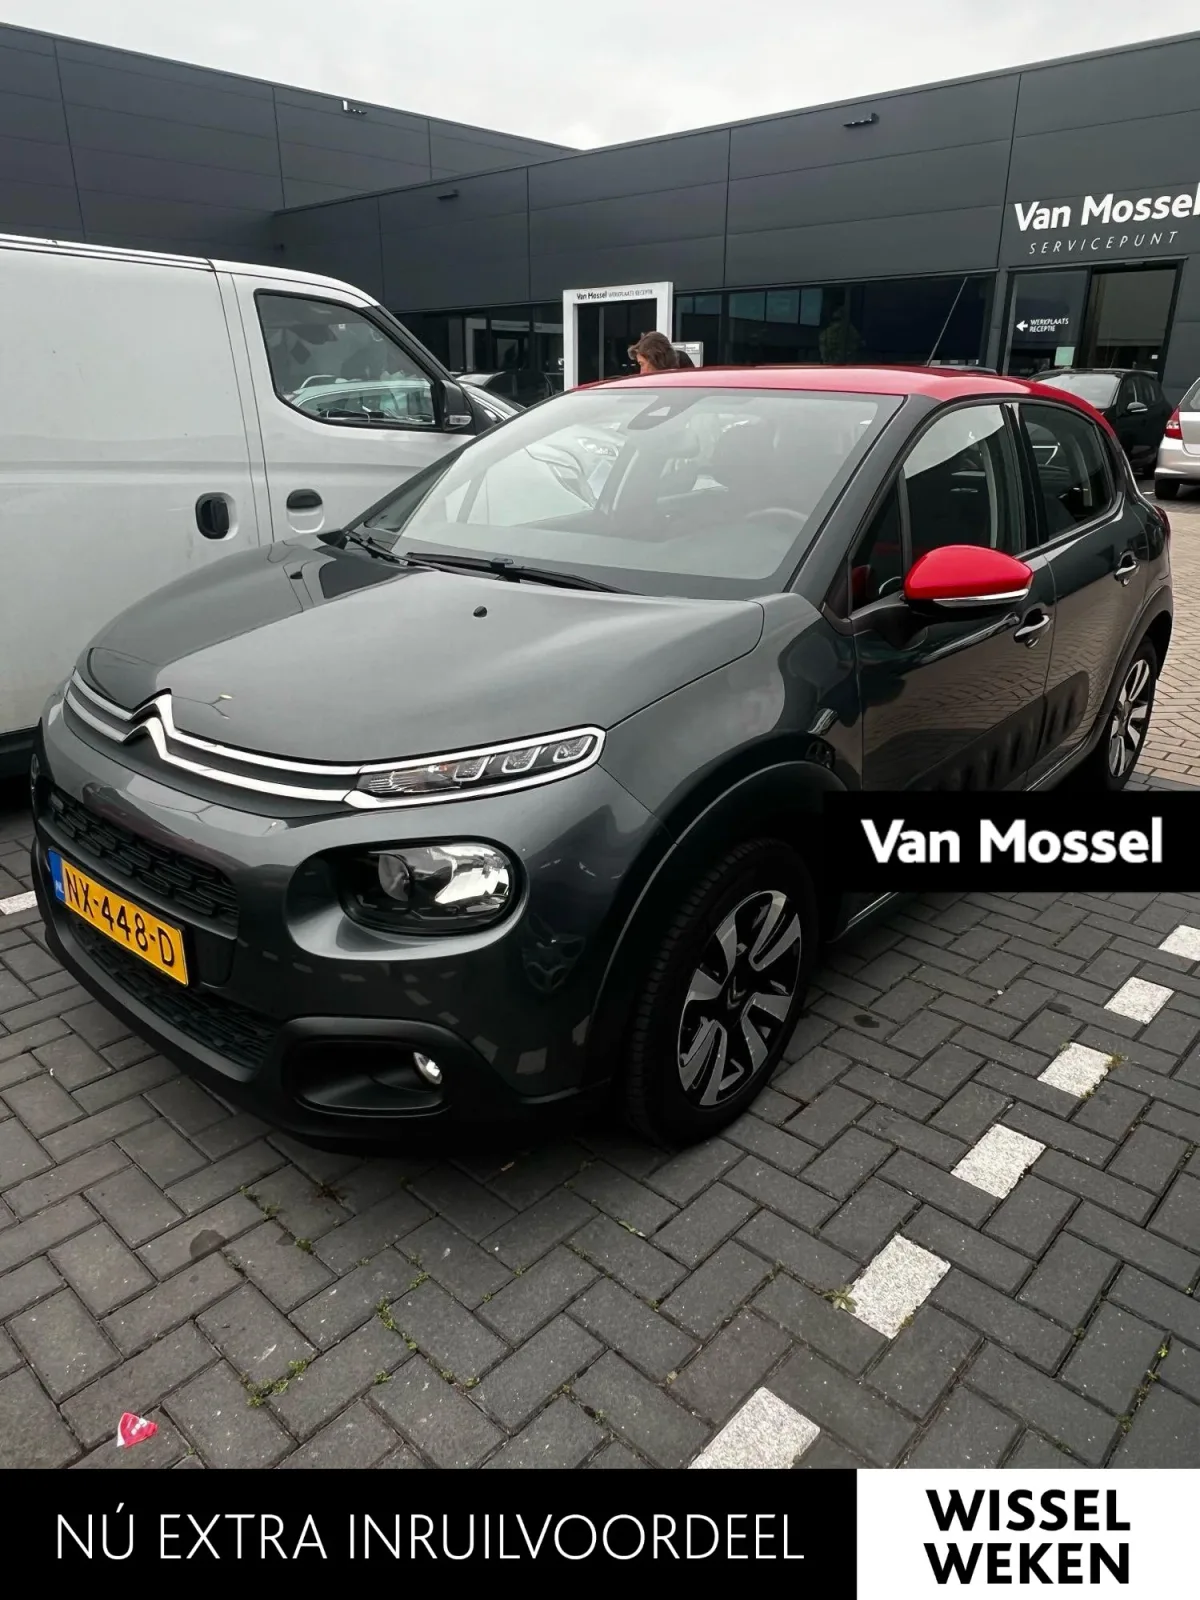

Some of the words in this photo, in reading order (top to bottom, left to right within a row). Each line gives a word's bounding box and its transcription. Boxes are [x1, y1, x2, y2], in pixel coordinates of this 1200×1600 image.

[1014, 201, 1071, 231] Van
[1081, 182, 1200, 226] Mossel
[1029, 231, 1178, 254] SERVICEPUNT
[576, 292, 588, 300] Van
[588, 290, 608, 299] Mossel
[1029, 325, 1056, 333] RECEPTIE
[1030, 317, 1069, 326] WERKPLAATS
[65, 867, 175, 968] NX-448-D
